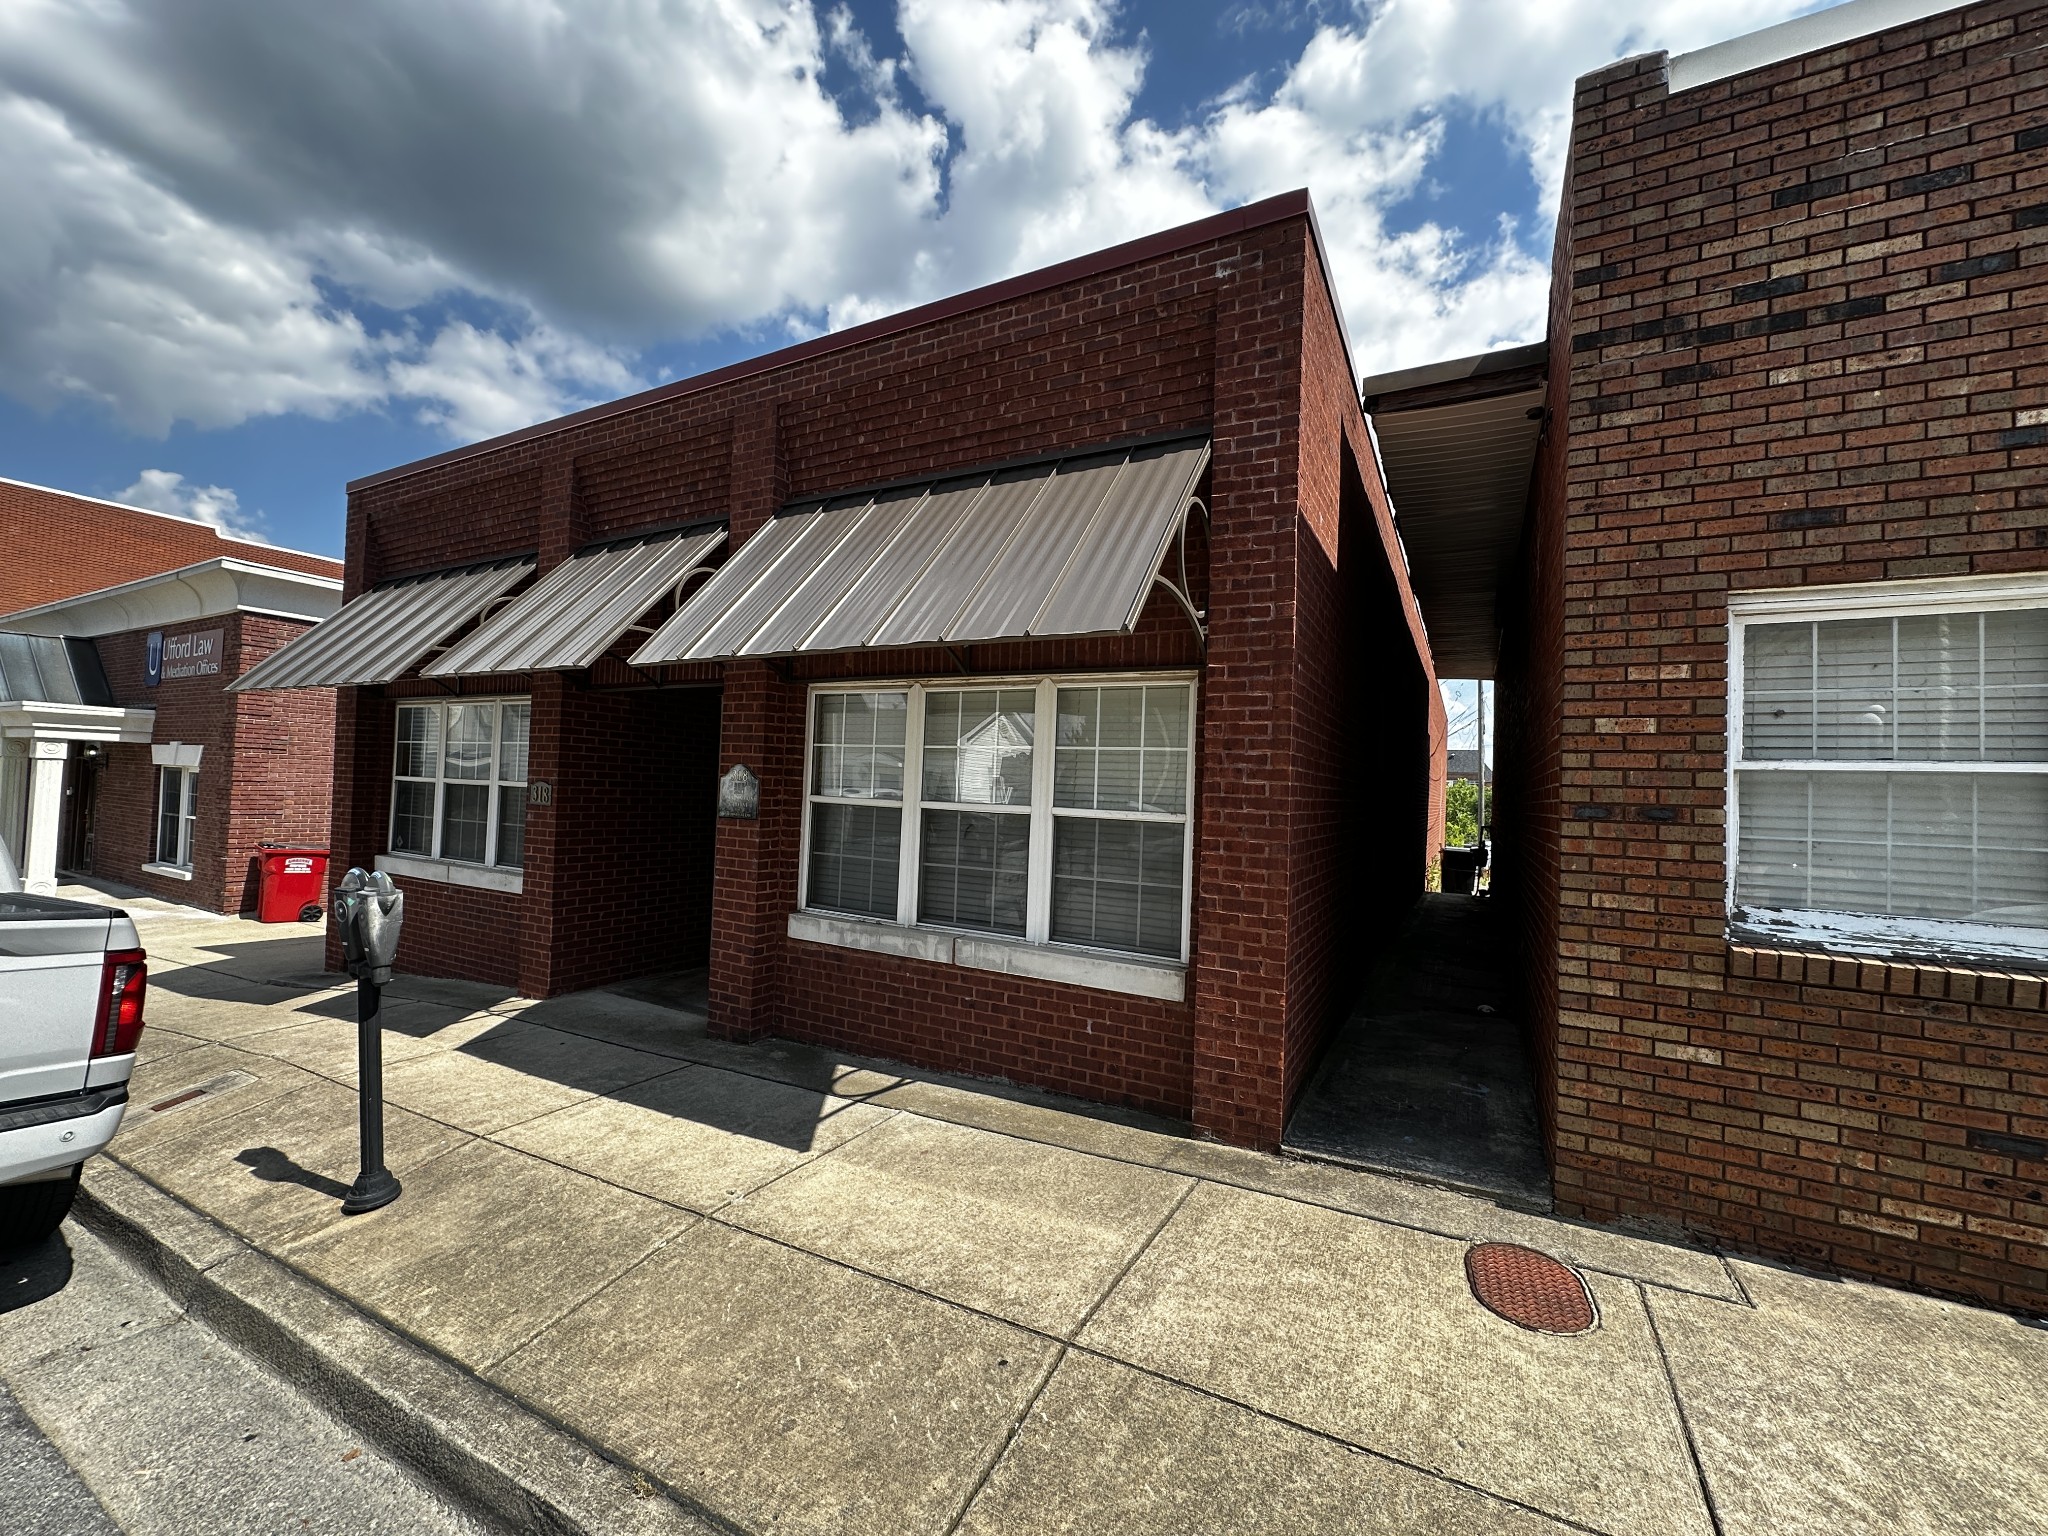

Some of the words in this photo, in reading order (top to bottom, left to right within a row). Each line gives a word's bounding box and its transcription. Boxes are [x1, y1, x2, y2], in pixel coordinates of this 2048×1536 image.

[162, 634, 192, 660] Ufford
[193, 635, 214, 657] Law
[149, 642, 160, 676] U
[161, 667, 166, 679] &
[167, 662, 195, 678] Mediation
[196, 659, 219, 675] Offices
[731, 769, 749, 781] 318
[532, 785, 549, 803] 318
